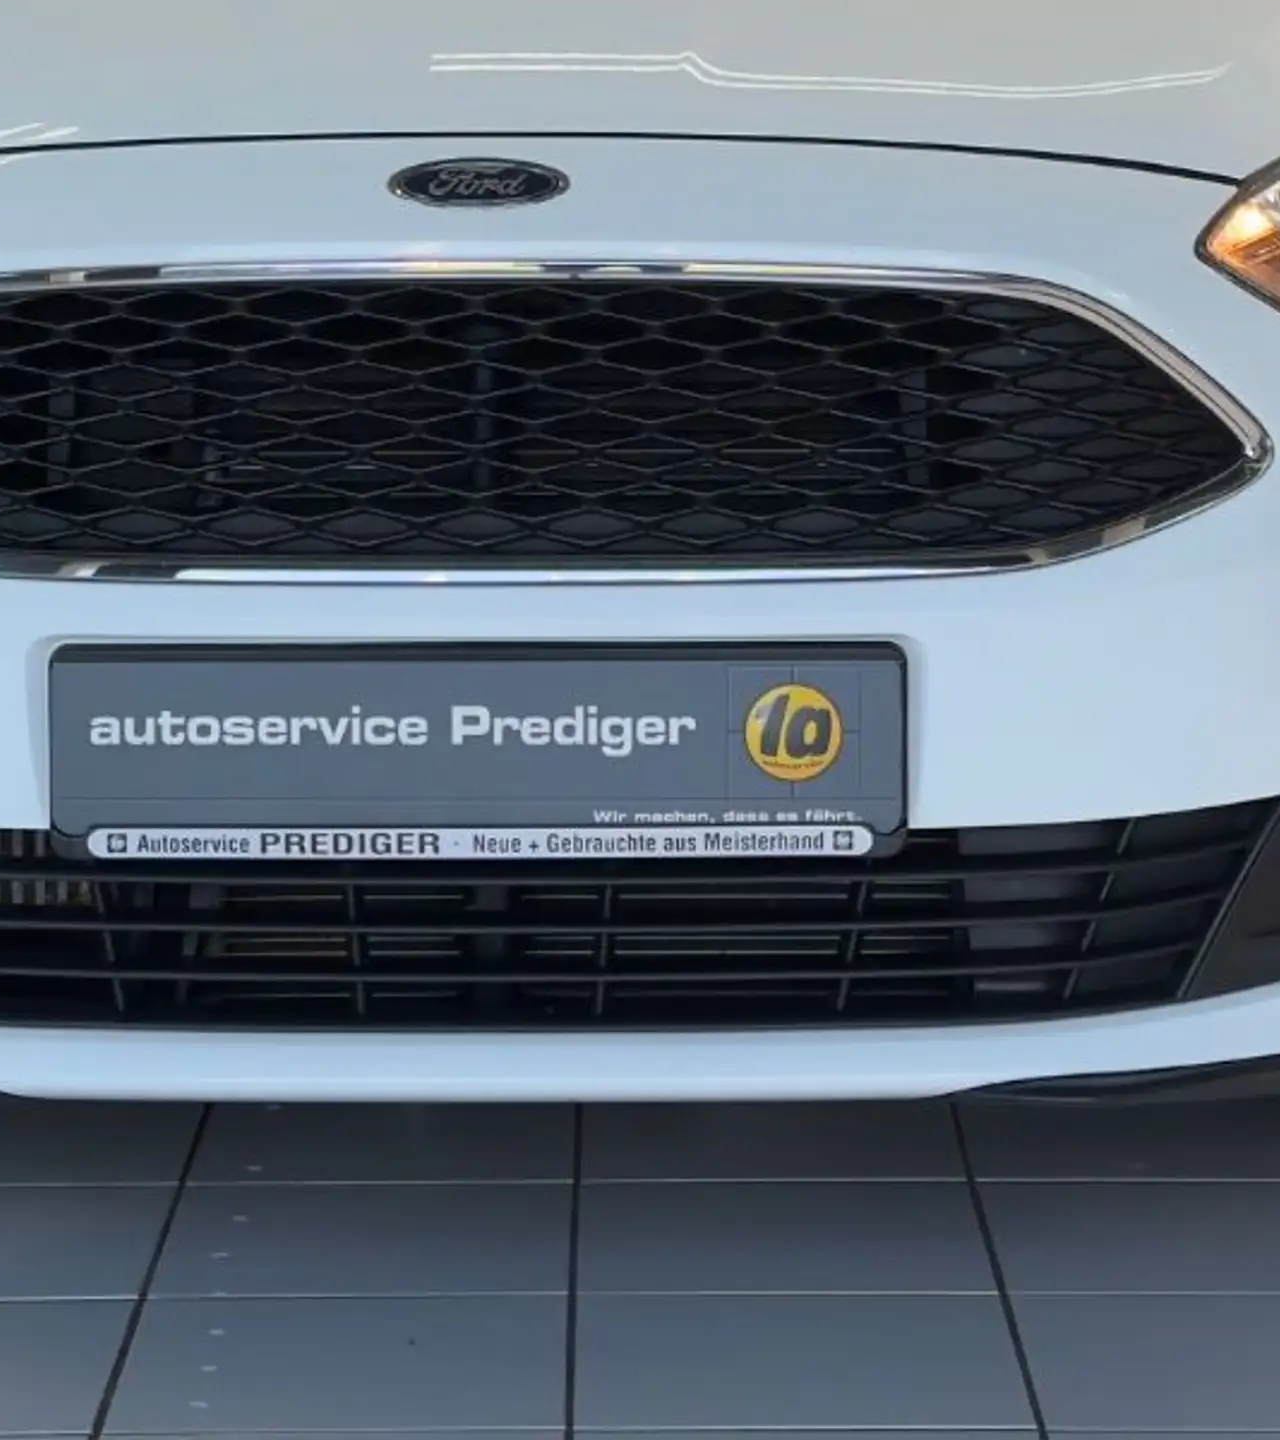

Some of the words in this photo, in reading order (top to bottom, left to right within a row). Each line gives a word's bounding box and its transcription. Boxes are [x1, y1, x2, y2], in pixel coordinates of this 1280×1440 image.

[428, 169, 528, 197] Ford
[88, 705, 430, 746] autoservice
[451, 705, 698, 758] Prediger
[593, 809, 626, 823] Wir
[634, 809, 716, 824] machen,
[137, 833, 251, 854] Autoservice
[260, 832, 441, 855] PREDIGER
[473, 834, 522, 854] Neue
[546, 832, 657, 854] Gebrauchte
[663, 836, 697, 852] aus
[703, 830, 826, 852] Meisterhand
